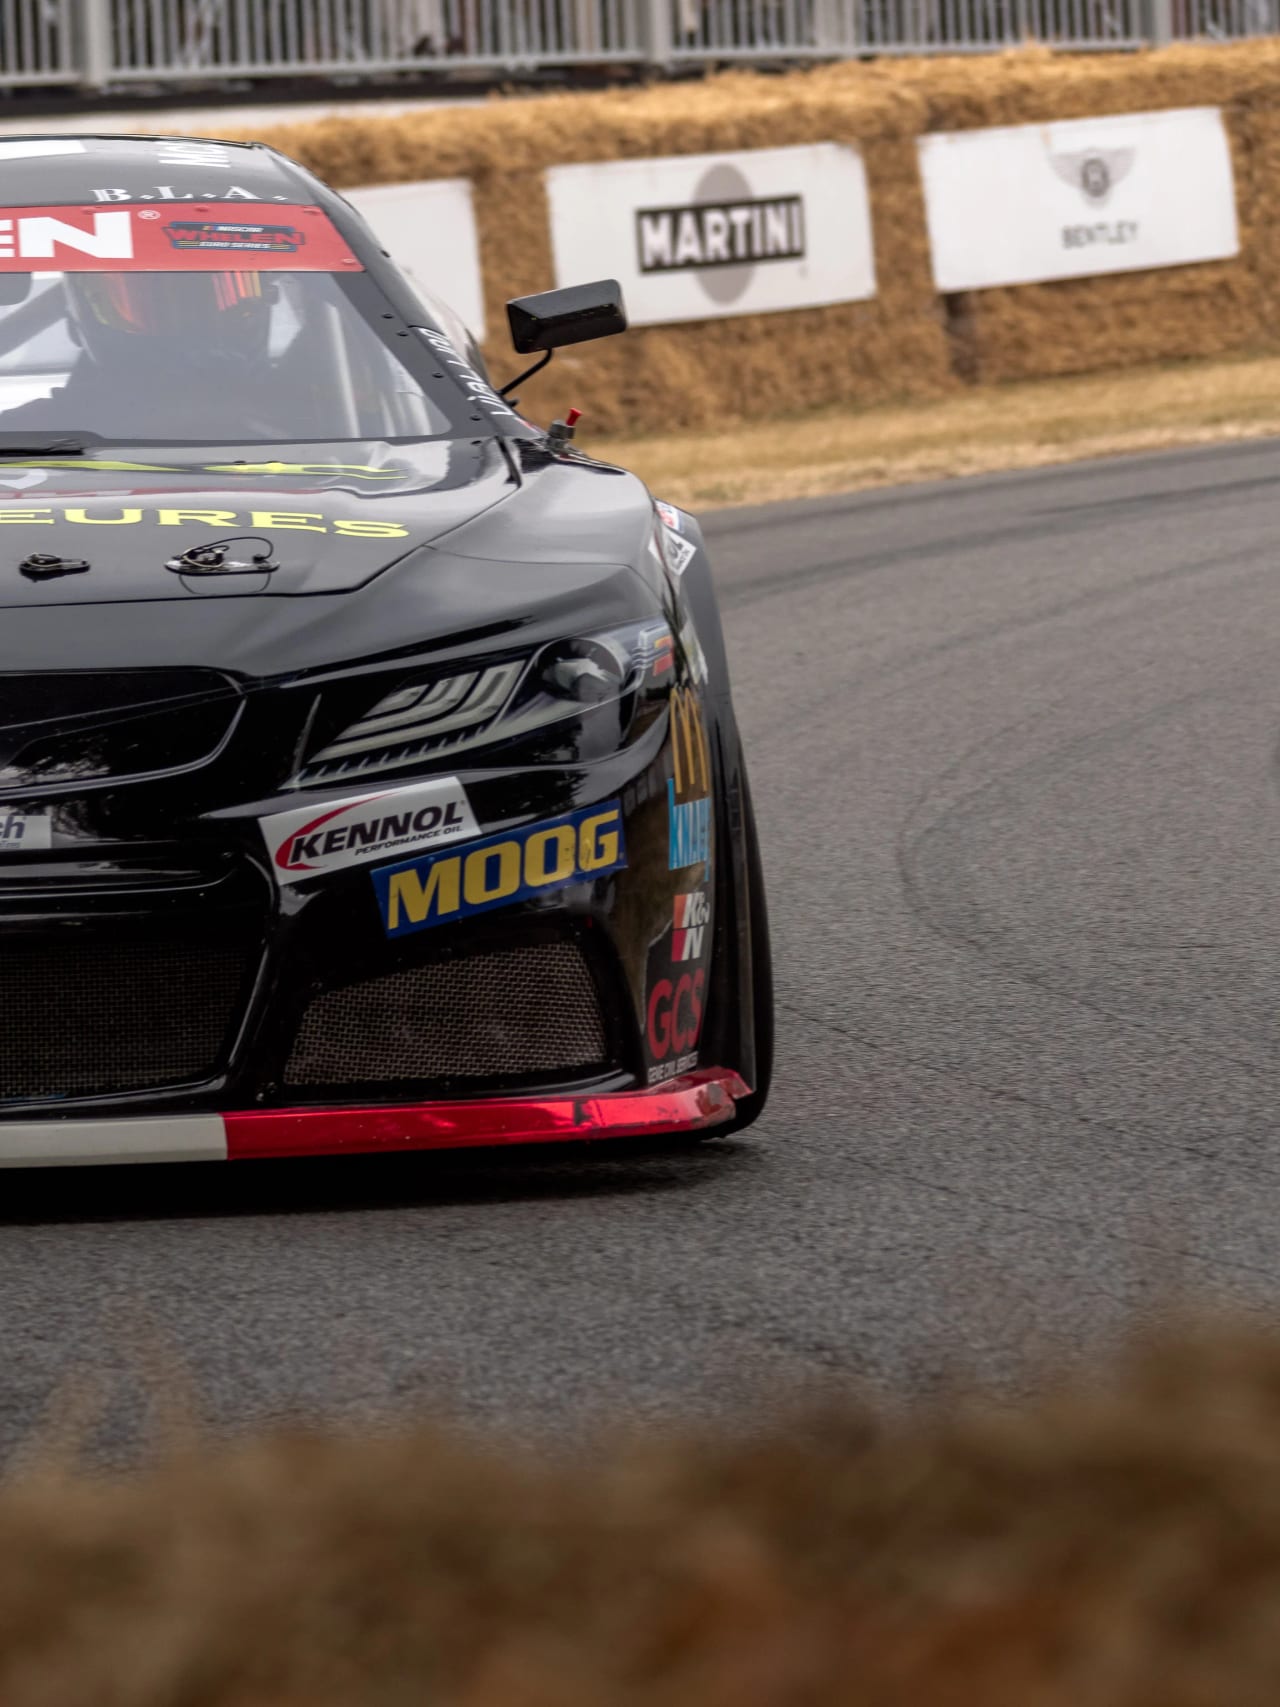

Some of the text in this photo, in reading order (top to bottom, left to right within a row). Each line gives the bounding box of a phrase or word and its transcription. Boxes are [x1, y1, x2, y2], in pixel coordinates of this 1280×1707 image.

[167, 228, 300, 245] WHELEN
[641, 200, 802, 267] MARTINI
[290, 802, 463, 863] KENNOL
[355, 826, 463, 856] PERFORMANCE OIL
[388, 809, 619, 931] MOOG
[647, 967, 705, 1060] GCS
